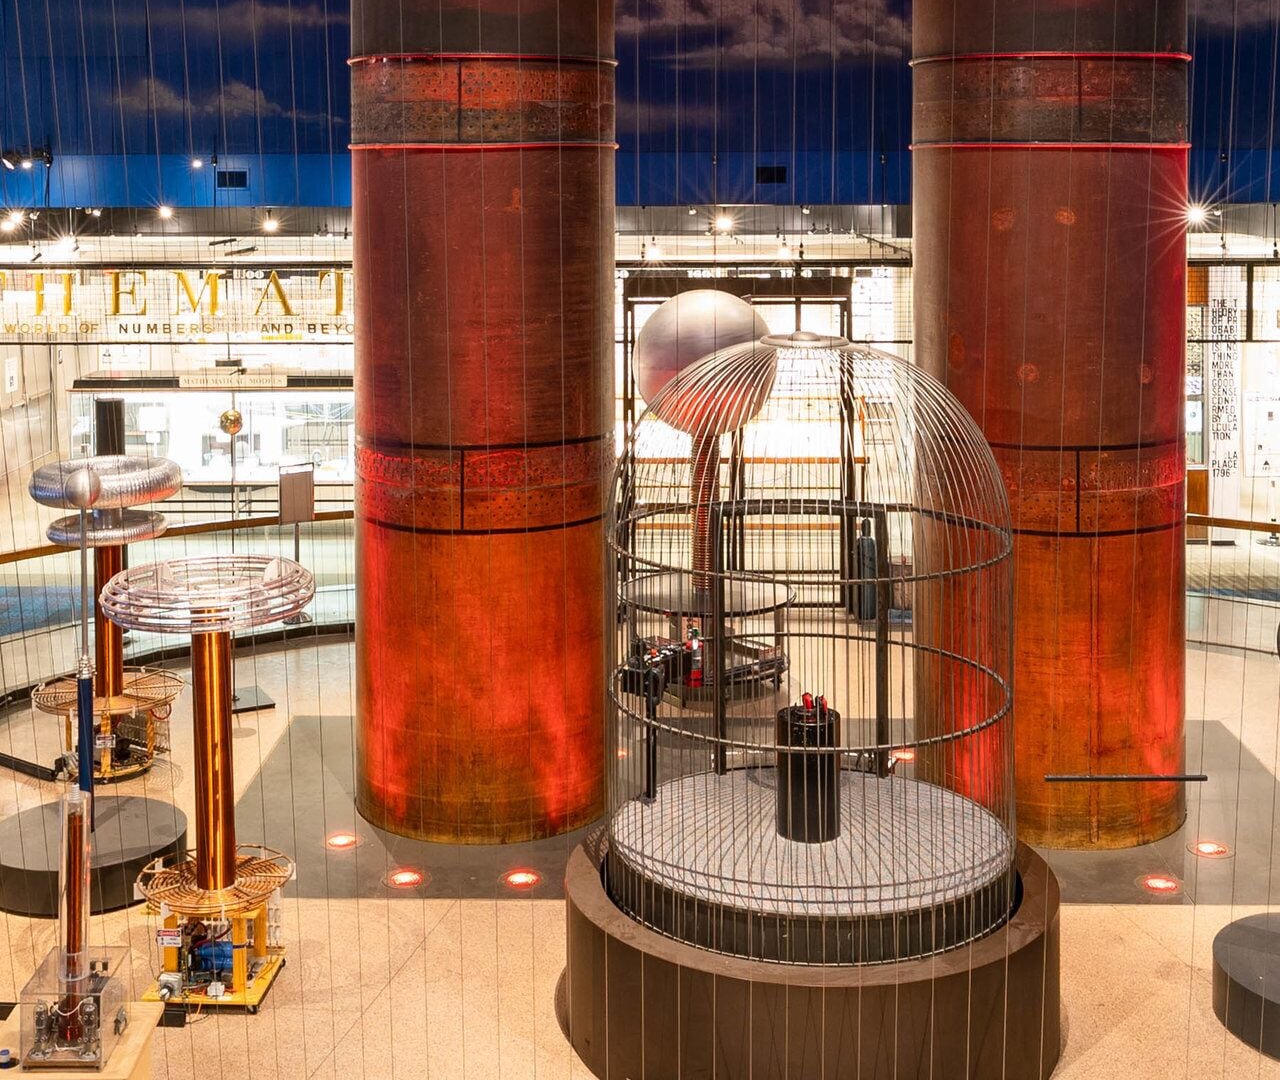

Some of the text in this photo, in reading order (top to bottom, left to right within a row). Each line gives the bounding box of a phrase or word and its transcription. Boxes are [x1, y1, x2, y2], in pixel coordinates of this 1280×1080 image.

[4, 323, 69, 334] WORLD
[79, 323, 99, 334] OF
[119, 323, 214, 334] NUMBERS
[261, 323, 294, 334] AND
[1212, 352, 1238, 360] THING
[1212, 370, 1234, 378] THAN
[1211, 379, 1234, 387] GOOD
[1212, 388, 1237, 396] SENSE
[1212, 432, 1231, 440] TION
[1211, 460, 1237, 468] PLACE
